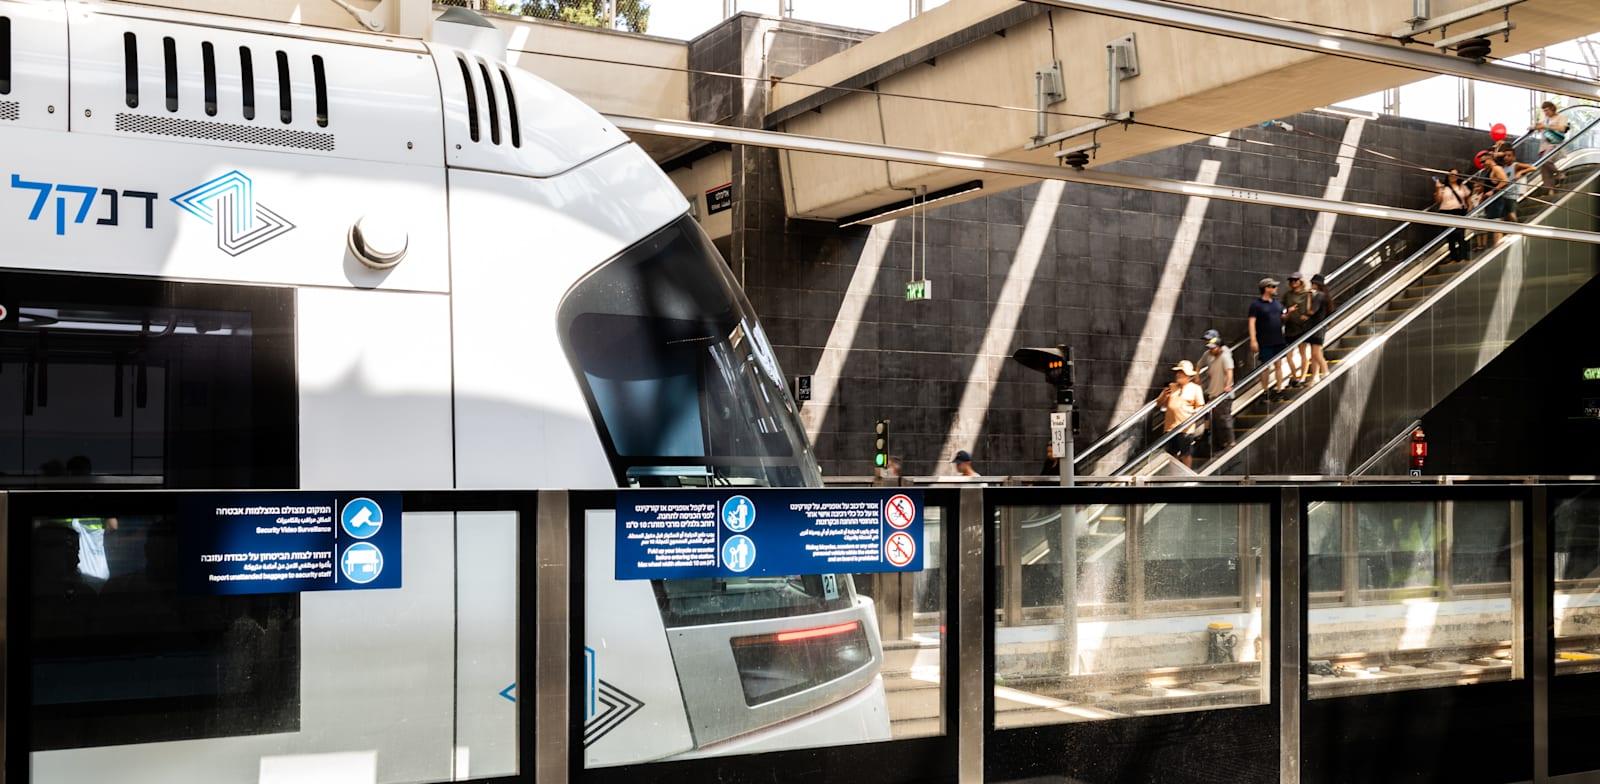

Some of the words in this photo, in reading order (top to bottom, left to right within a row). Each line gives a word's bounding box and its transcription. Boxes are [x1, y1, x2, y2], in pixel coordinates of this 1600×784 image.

[11, 174, 158, 235] דנקל
[1054, 430, 1062, 441] 13
[281, 506, 305, 514] מצולם
[306, 507, 331, 515] המקום
[201, 554, 223, 562] עזובה
[248, 552, 259, 561] על
[260, 552, 290, 562] הביטחון
[291, 551, 312, 559] לצוות
[209, 574, 229, 582] Report
[295, 571, 317, 579] security
[824, 575, 835, 594] 27
